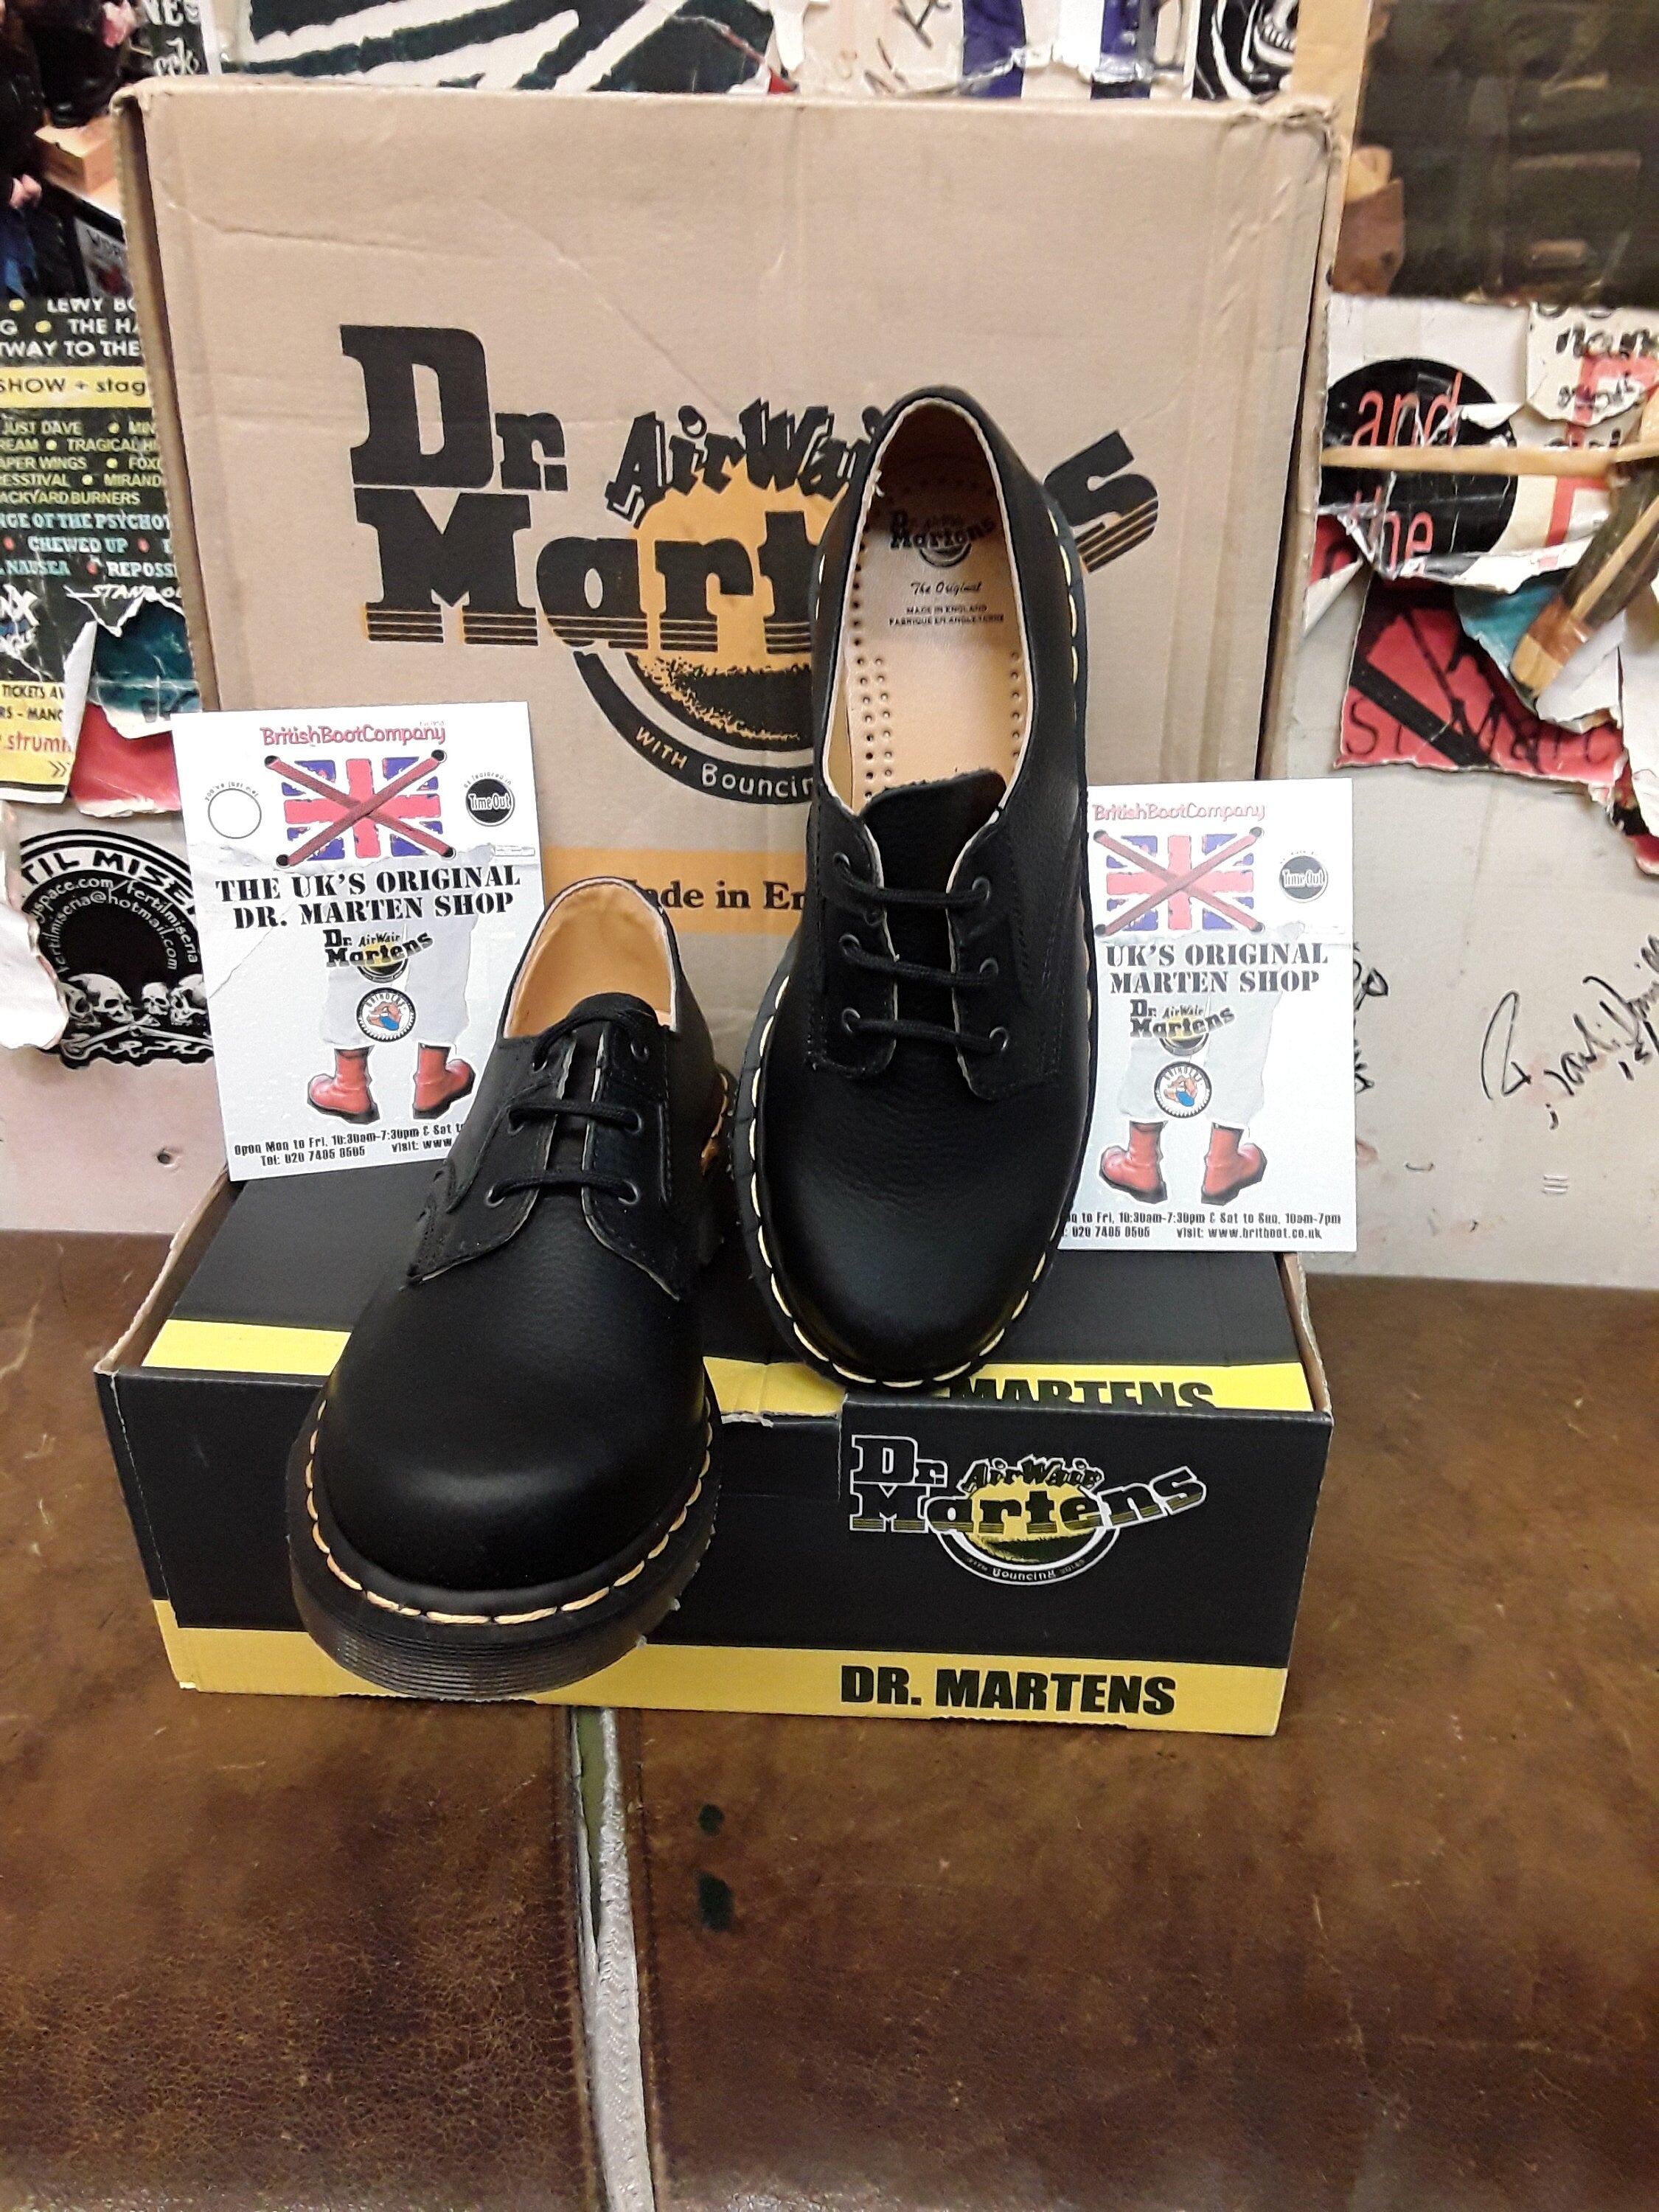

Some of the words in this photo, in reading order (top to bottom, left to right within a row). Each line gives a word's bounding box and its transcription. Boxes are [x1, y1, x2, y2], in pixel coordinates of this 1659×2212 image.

[47, 298, 102, 313] LEWY
[68, 319, 107, 335] THE
[63, 341, 95, 358] TO
[100, 340, 140, 358] THE
[0, 378, 65, 393] SHOW
[97, 378, 145, 396] stag
[340, 324, 568, 491] Dr.
[1353, 370, 1463, 447] and
[41, 421, 83, 435] DAVE
[38, 456, 88, 470] WINGS
[70, 492, 141, 505] BURNERS
[27, 537, 102, 553] CHEWED
[104, 538, 129, 553] UP
[5, 559, 71, 577] NAUSEA
[911, 582, 931, 595] The
[935, 580, 981, 596] Original
[906, 605, 931, 615] MADE
[945, 604, 987, 614] ENGLAND
[2, 684, 45, 699] TICKETS
[260, 724, 445, 746] BritishBootCompany
[636, 726, 688, 769] WITH
[468, 793, 492, 810] Time
[492, 792, 511, 810] Out
[1092, 803, 1265, 821] BritishBootCompany
[215, 877, 281, 902] THE
[291, 872, 366, 898] UK'S
[376, 865, 521, 894] ORIGINAL
[716, 880, 751, 909] in
[233, 905, 288, 929] DR.
[301, 897, 422, 926] MARTEN
[435, 892, 513, 917] SHOP
[323, 929, 352, 947] Dr.
[358, 932, 400, 947] AirWair
[324, 932, 434, 967] Martens
[1106, 945, 1175, 967] UK'S
[1185, 942, 1329, 967] ORIGINAL
[1110, 971, 1228, 994] MARTEN
[1239, 970, 1320, 993] SHOP
[1130, 999, 1156, 1018] Dr.
[1130, 1007, 1236, 1038] Martens
[265, 1141, 289, 1152] Mon
[293, 1139, 305, 1150] to
[433, 1124, 452, 1136] Sat
[285, 1152, 305, 1164] 020
[1082, 1212, 1093, 1223] to
[1220, 1212, 1238, 1224] Sat
[1243, 1213, 1253, 1224] to
[1285, 1213, 1341, 1226] 10am-7pm
[1072, 1226, 1091, 1238] 020
[851, 1434, 948, 1487] Dr.
[958, 1454, 1105, 1495] AirWair
[849, 1465, 1207, 1534] Martens
[841, 1665, 921, 1705] DR.
[936, 1669, 1177, 1715] MARTENS
